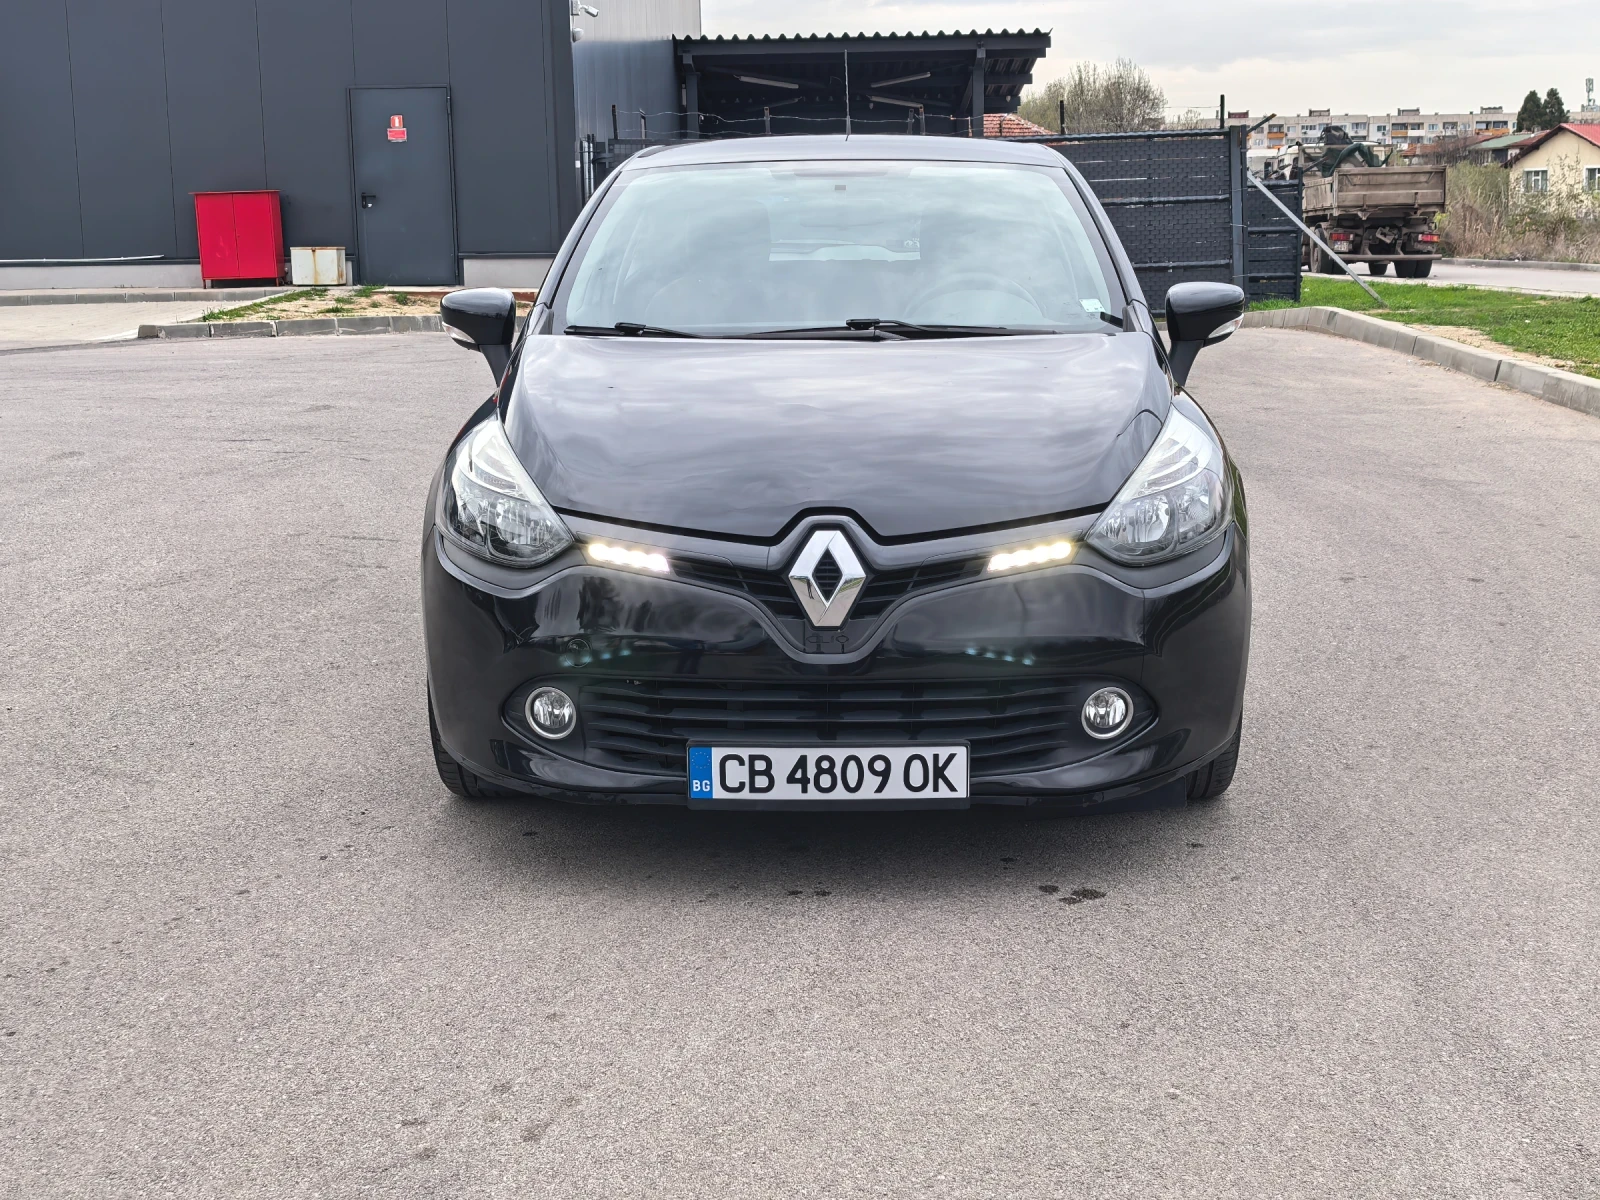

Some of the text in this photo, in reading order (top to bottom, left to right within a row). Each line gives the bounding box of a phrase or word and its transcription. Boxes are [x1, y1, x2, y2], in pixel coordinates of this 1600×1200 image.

[692, 779, 711, 792] BG
[719, 752, 958, 794] CB 4809 OK
